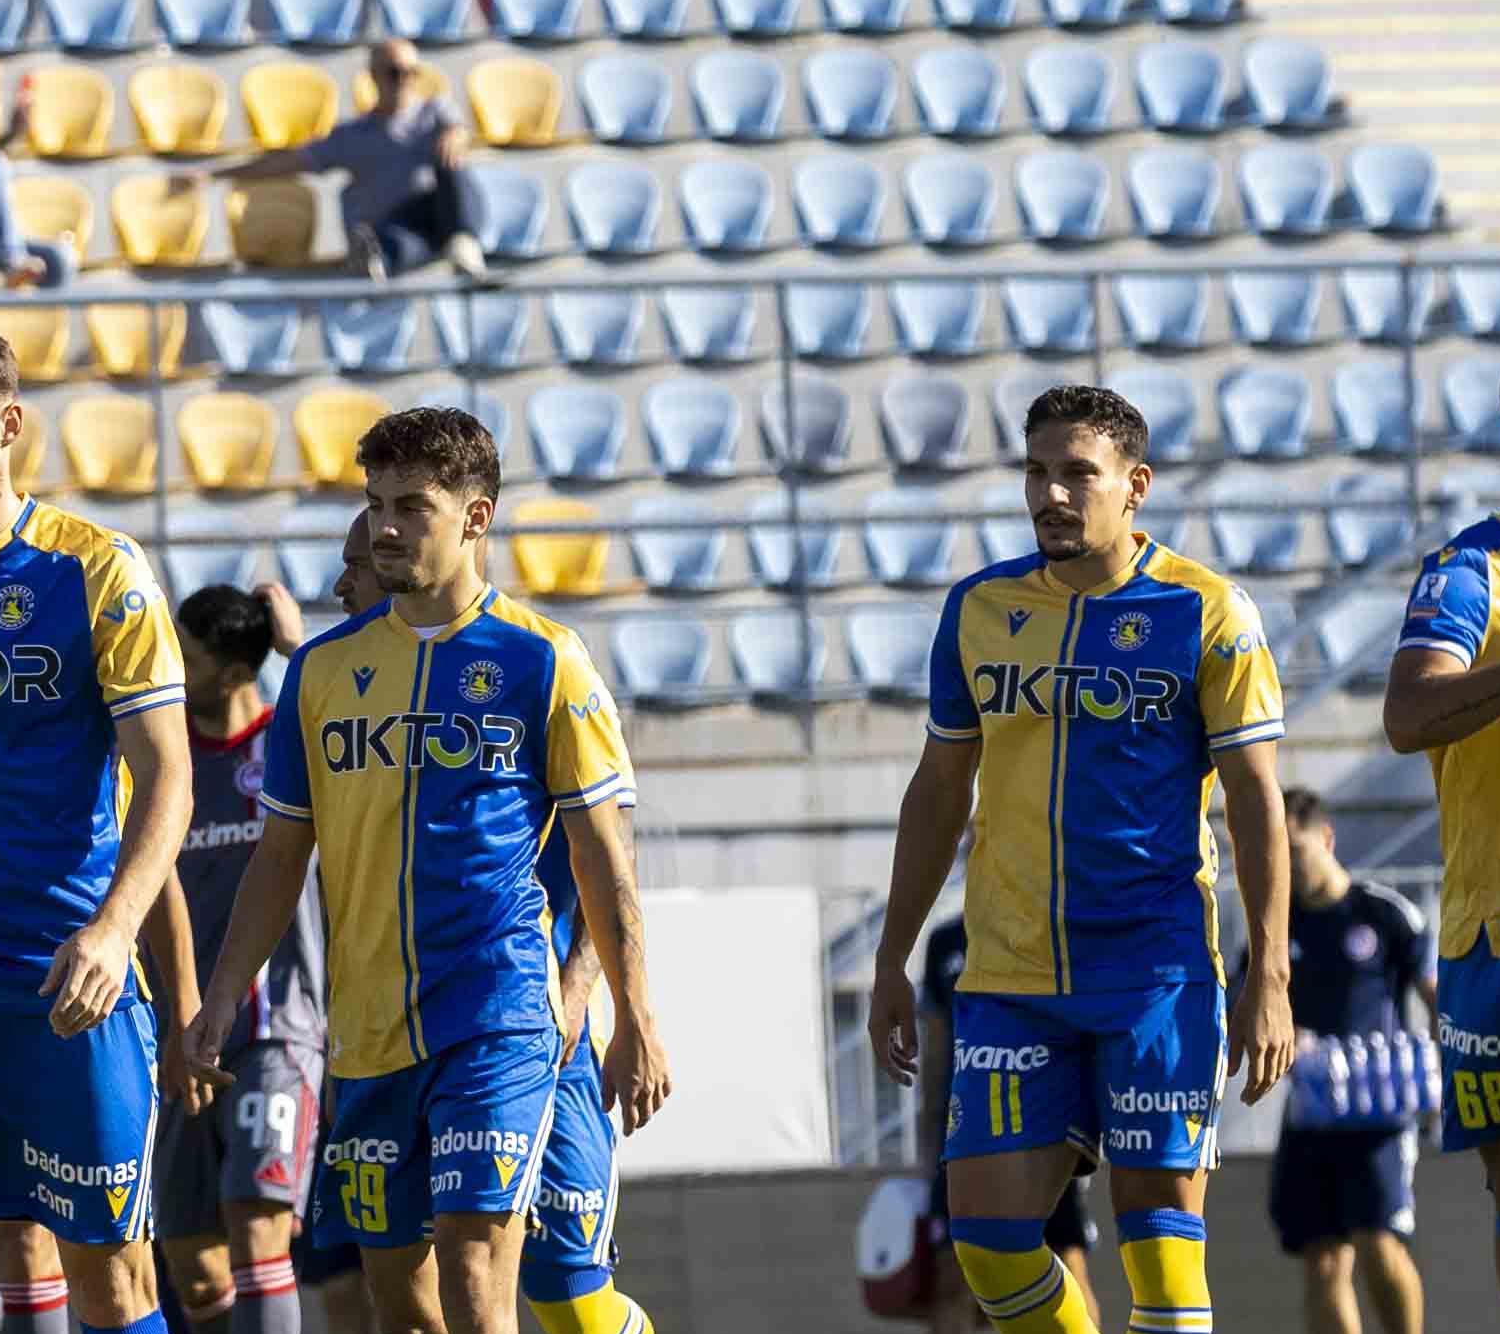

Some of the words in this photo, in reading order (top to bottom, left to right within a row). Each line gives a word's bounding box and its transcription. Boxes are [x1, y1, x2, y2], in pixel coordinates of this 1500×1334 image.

[238, 1090, 297, 1154] 99
[989, 1071, 1023, 1137] 11
[23, 1138, 138, 1187] badounas
